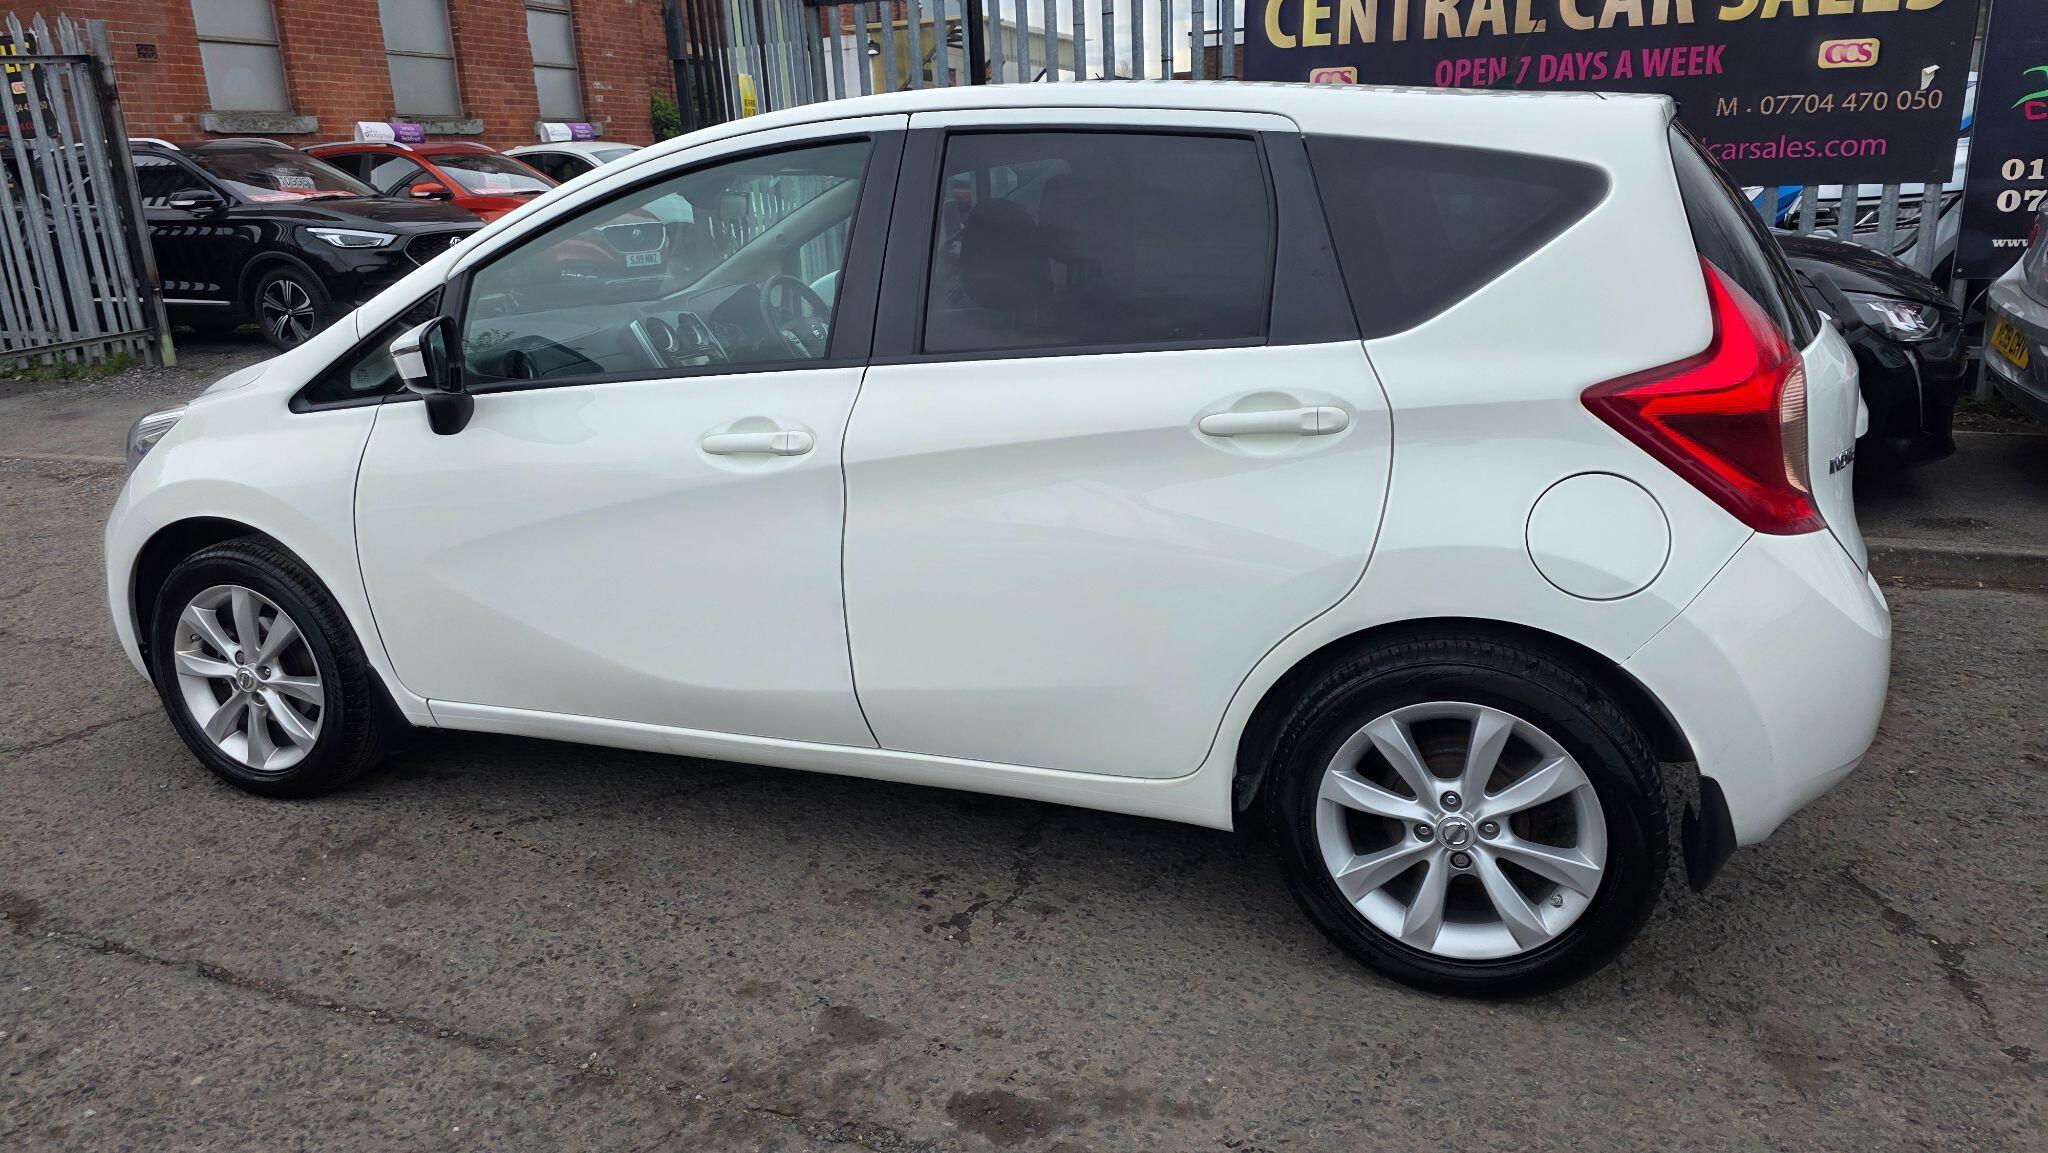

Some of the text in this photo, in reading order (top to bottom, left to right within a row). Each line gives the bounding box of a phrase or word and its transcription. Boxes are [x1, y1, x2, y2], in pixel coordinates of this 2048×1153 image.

[1435, 44, 1727, 88] OPEN 7 DAYS A WEEK
[1760, 93, 1834, 116] 07704
[1842, 91, 1889, 113] 470
[1896, 88, 1943, 111] 050
